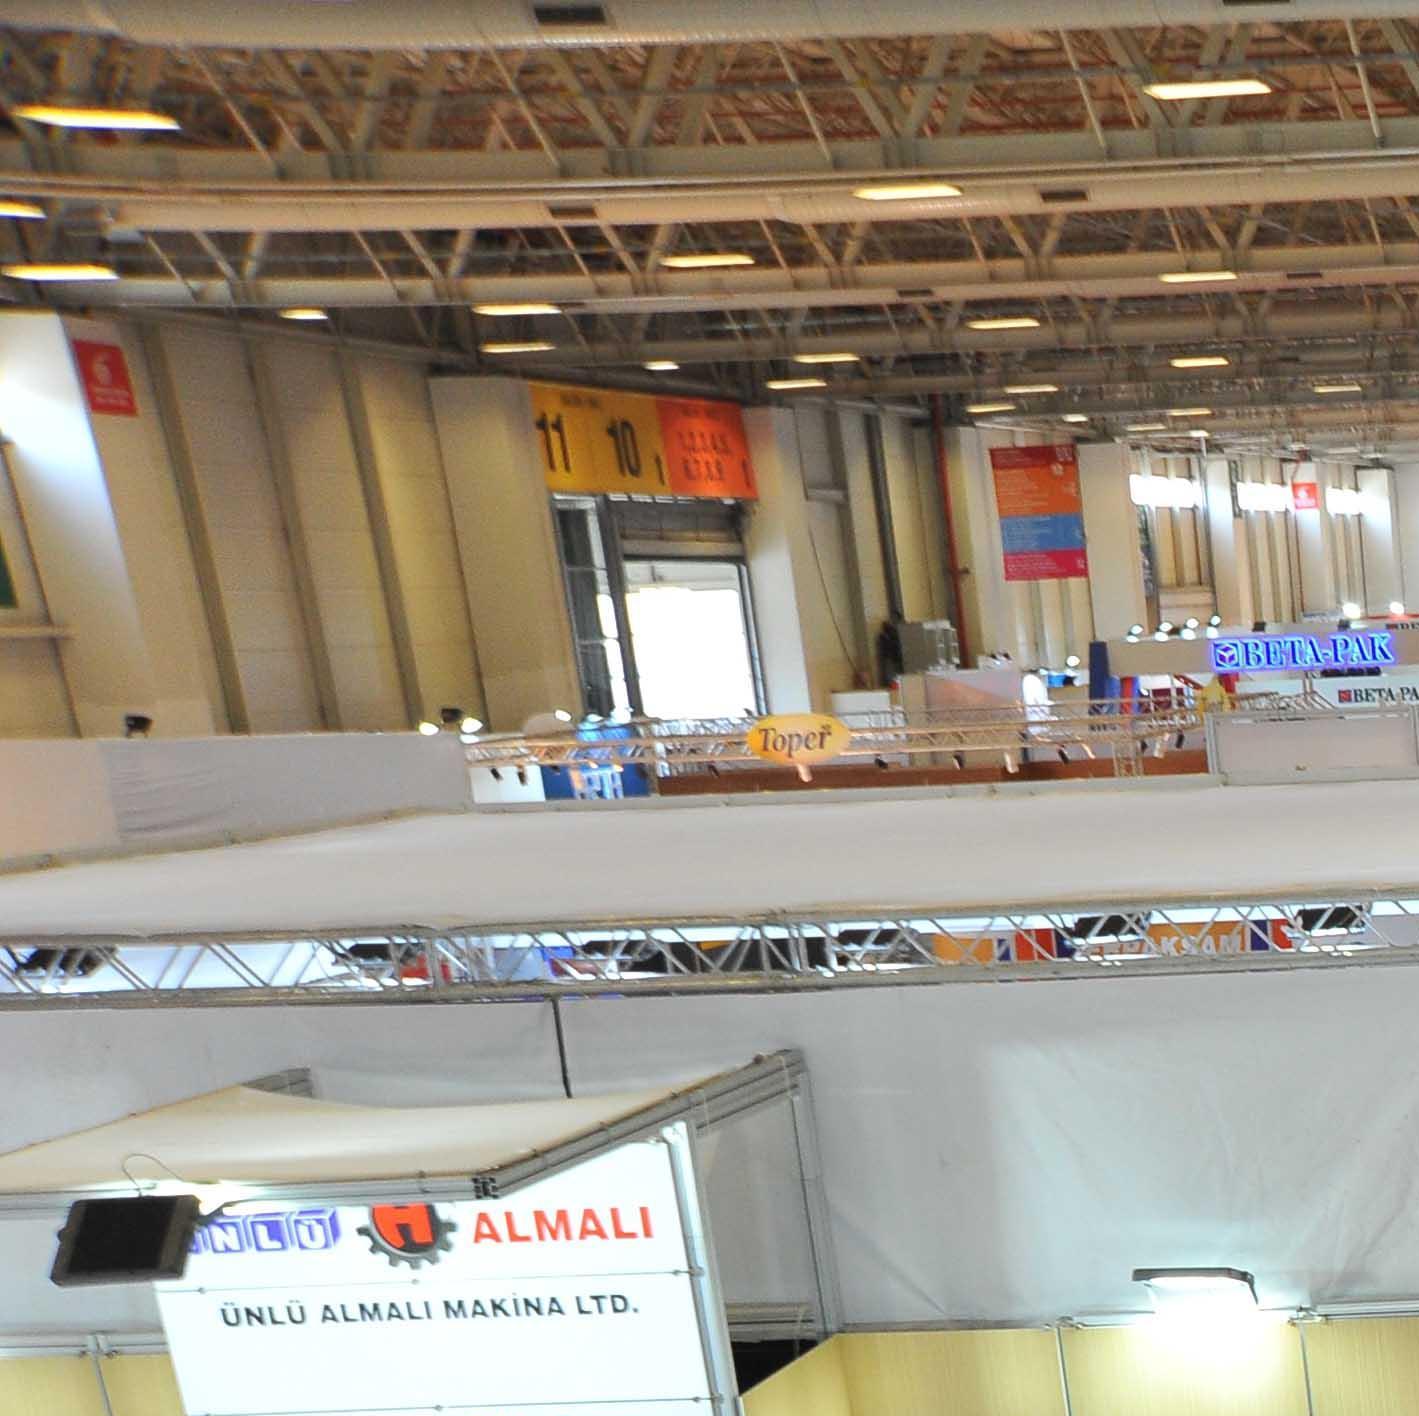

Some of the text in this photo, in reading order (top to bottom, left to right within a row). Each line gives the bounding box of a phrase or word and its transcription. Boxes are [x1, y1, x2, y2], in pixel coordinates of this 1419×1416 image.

[536, 412, 571, 473] 11
[607, 419, 641, 477] 10
[1243, 632, 1395, 667] BETA-PAK
[758, 725, 828, 755] Toper
[472, 1206, 654, 1245] ALMALI
[222, 1293, 639, 1328] ÜNLÜ ALMALI MAKİNA LTD.
